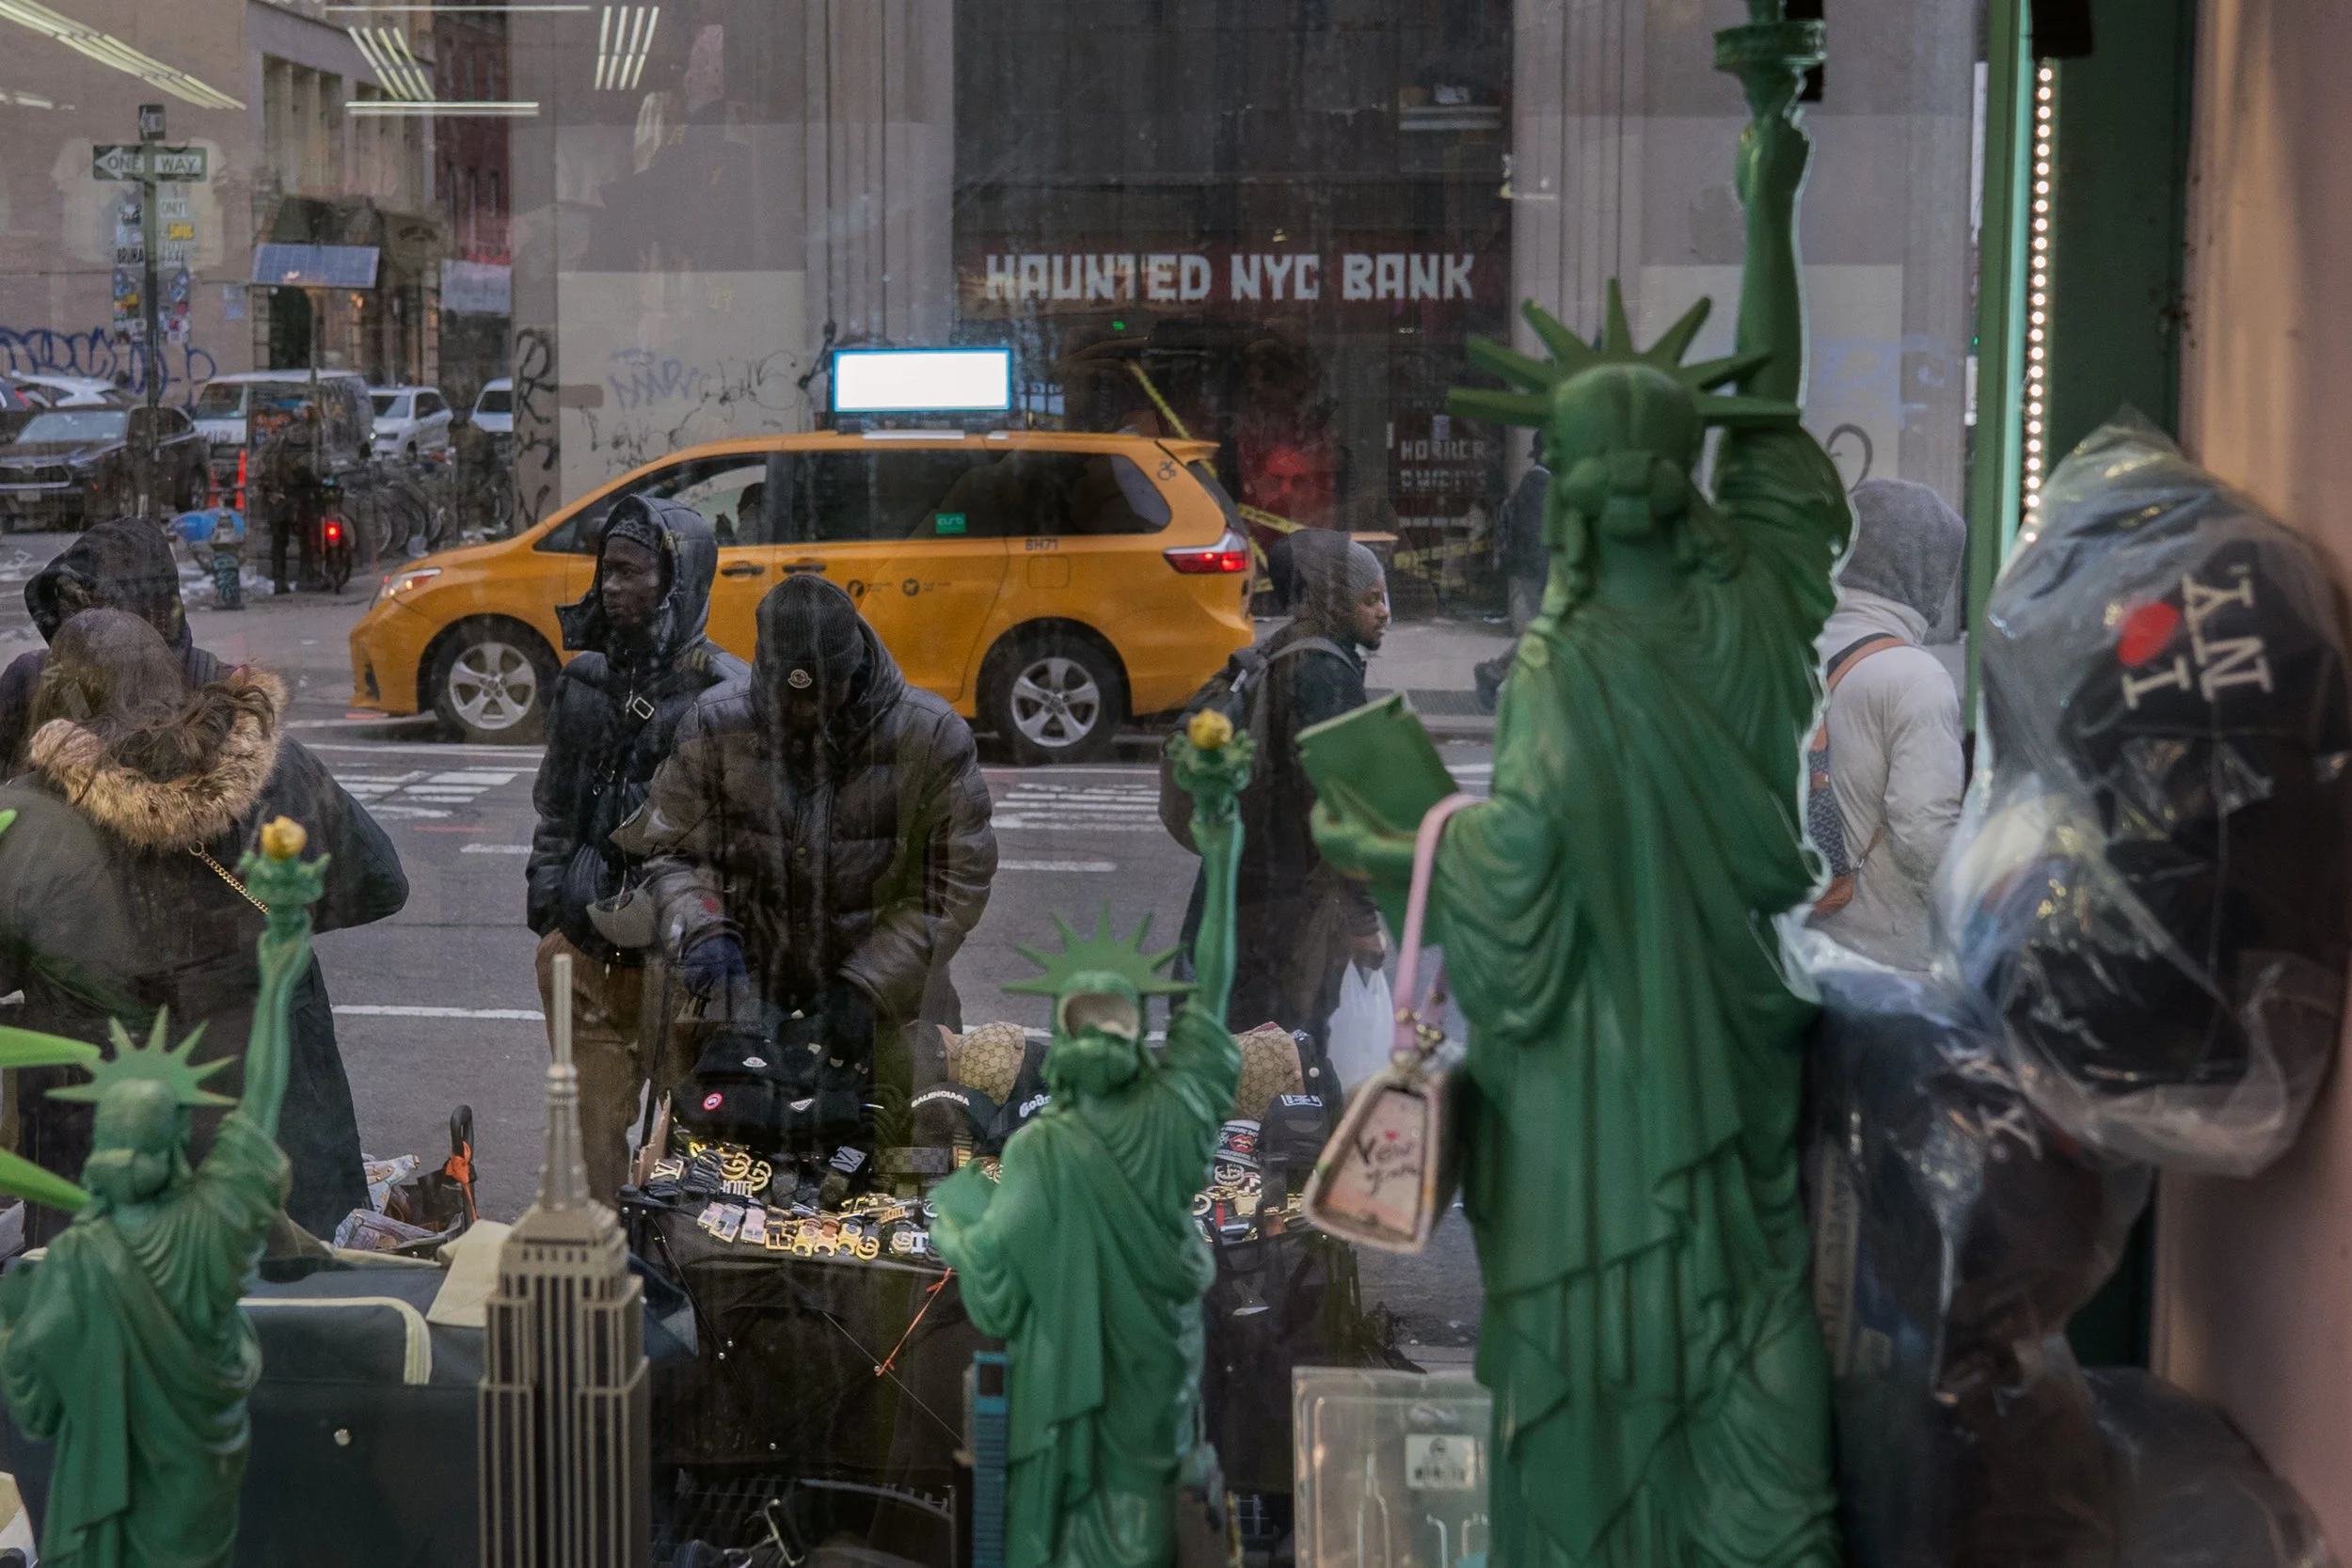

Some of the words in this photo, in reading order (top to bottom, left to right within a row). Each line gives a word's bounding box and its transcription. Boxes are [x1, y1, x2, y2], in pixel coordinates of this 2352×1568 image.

[108, 155, 139, 169] ONE
[161, 156, 198, 170] WAY
[985, 253, 1212, 301] HAUNTED
[1230, 252, 1321, 302] NYC
[1343, 252, 1475, 301] BANK
[2181, 573, 2274, 702] NY
[2122, 656, 2192, 710] I
[911, 1090, 970, 1108] BALENCIAGA
